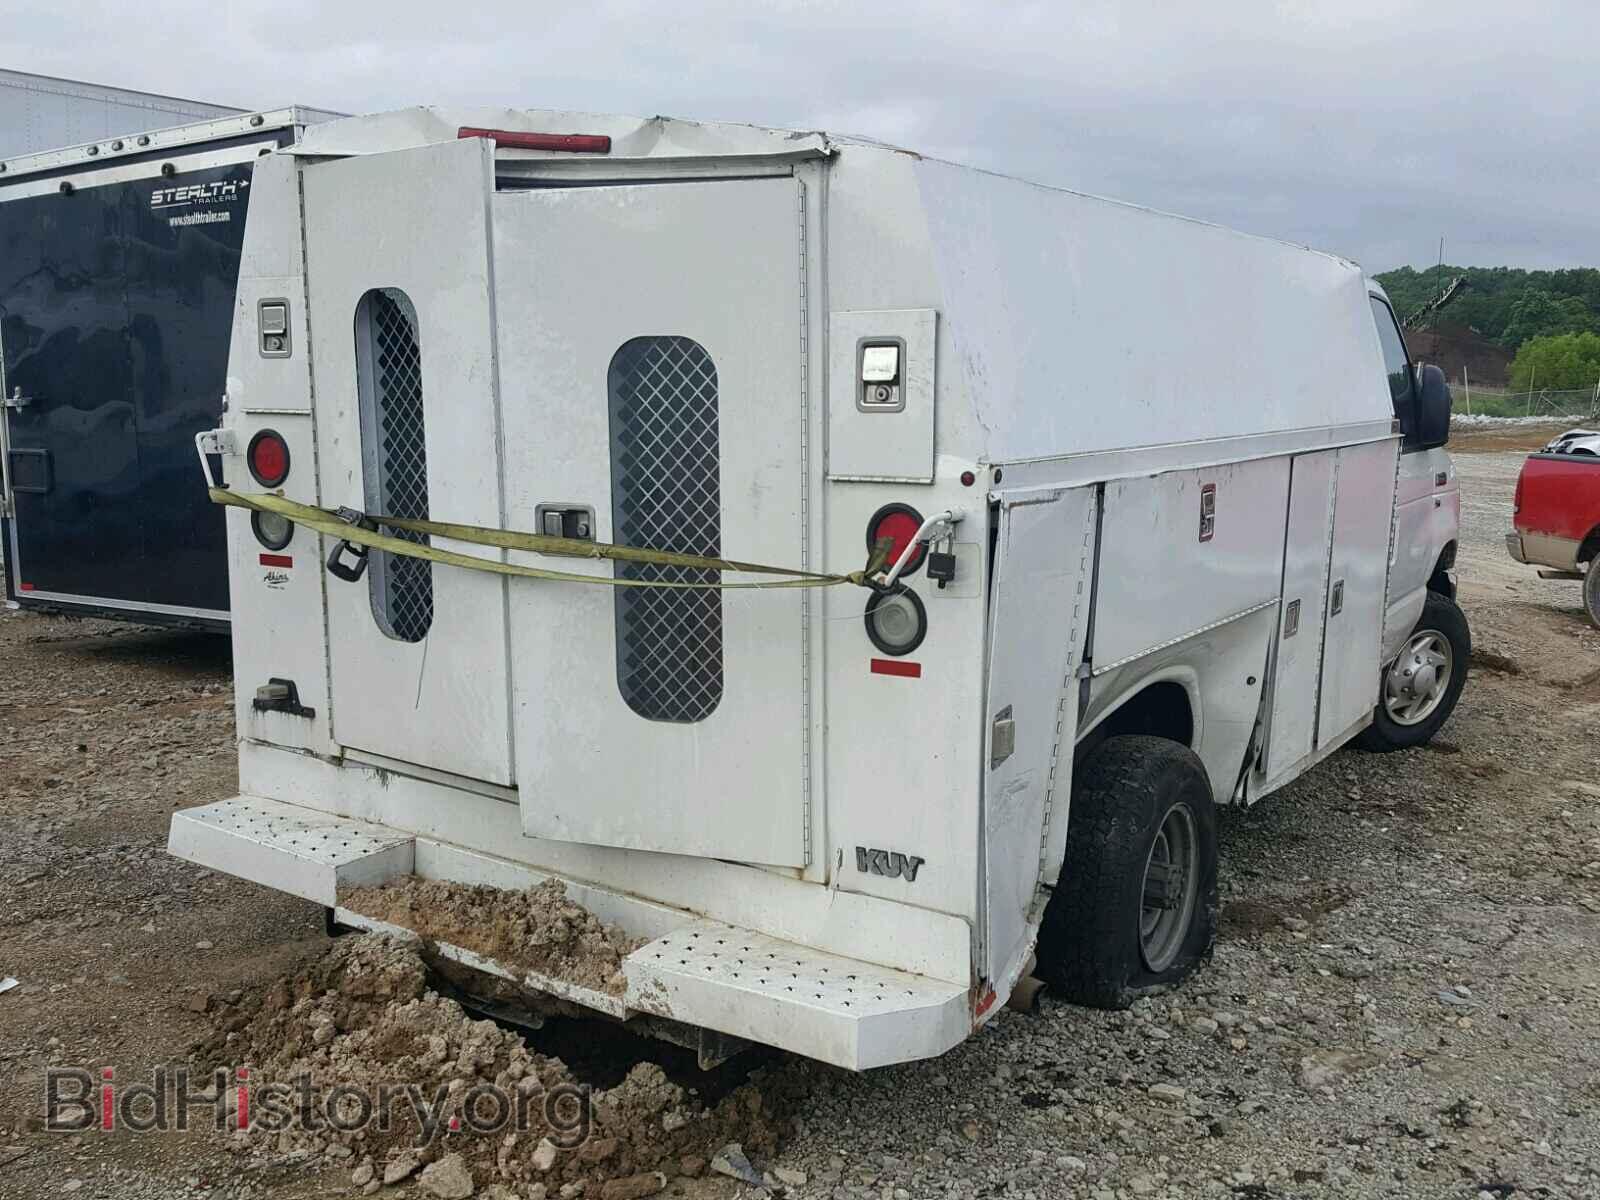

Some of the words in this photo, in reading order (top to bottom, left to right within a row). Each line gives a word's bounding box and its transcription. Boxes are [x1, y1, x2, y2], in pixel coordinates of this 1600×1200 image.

[151, 180, 238, 204] STEALTH
[193, 193, 238, 204] TRAILERS
[855, 846, 926, 882] KUV
